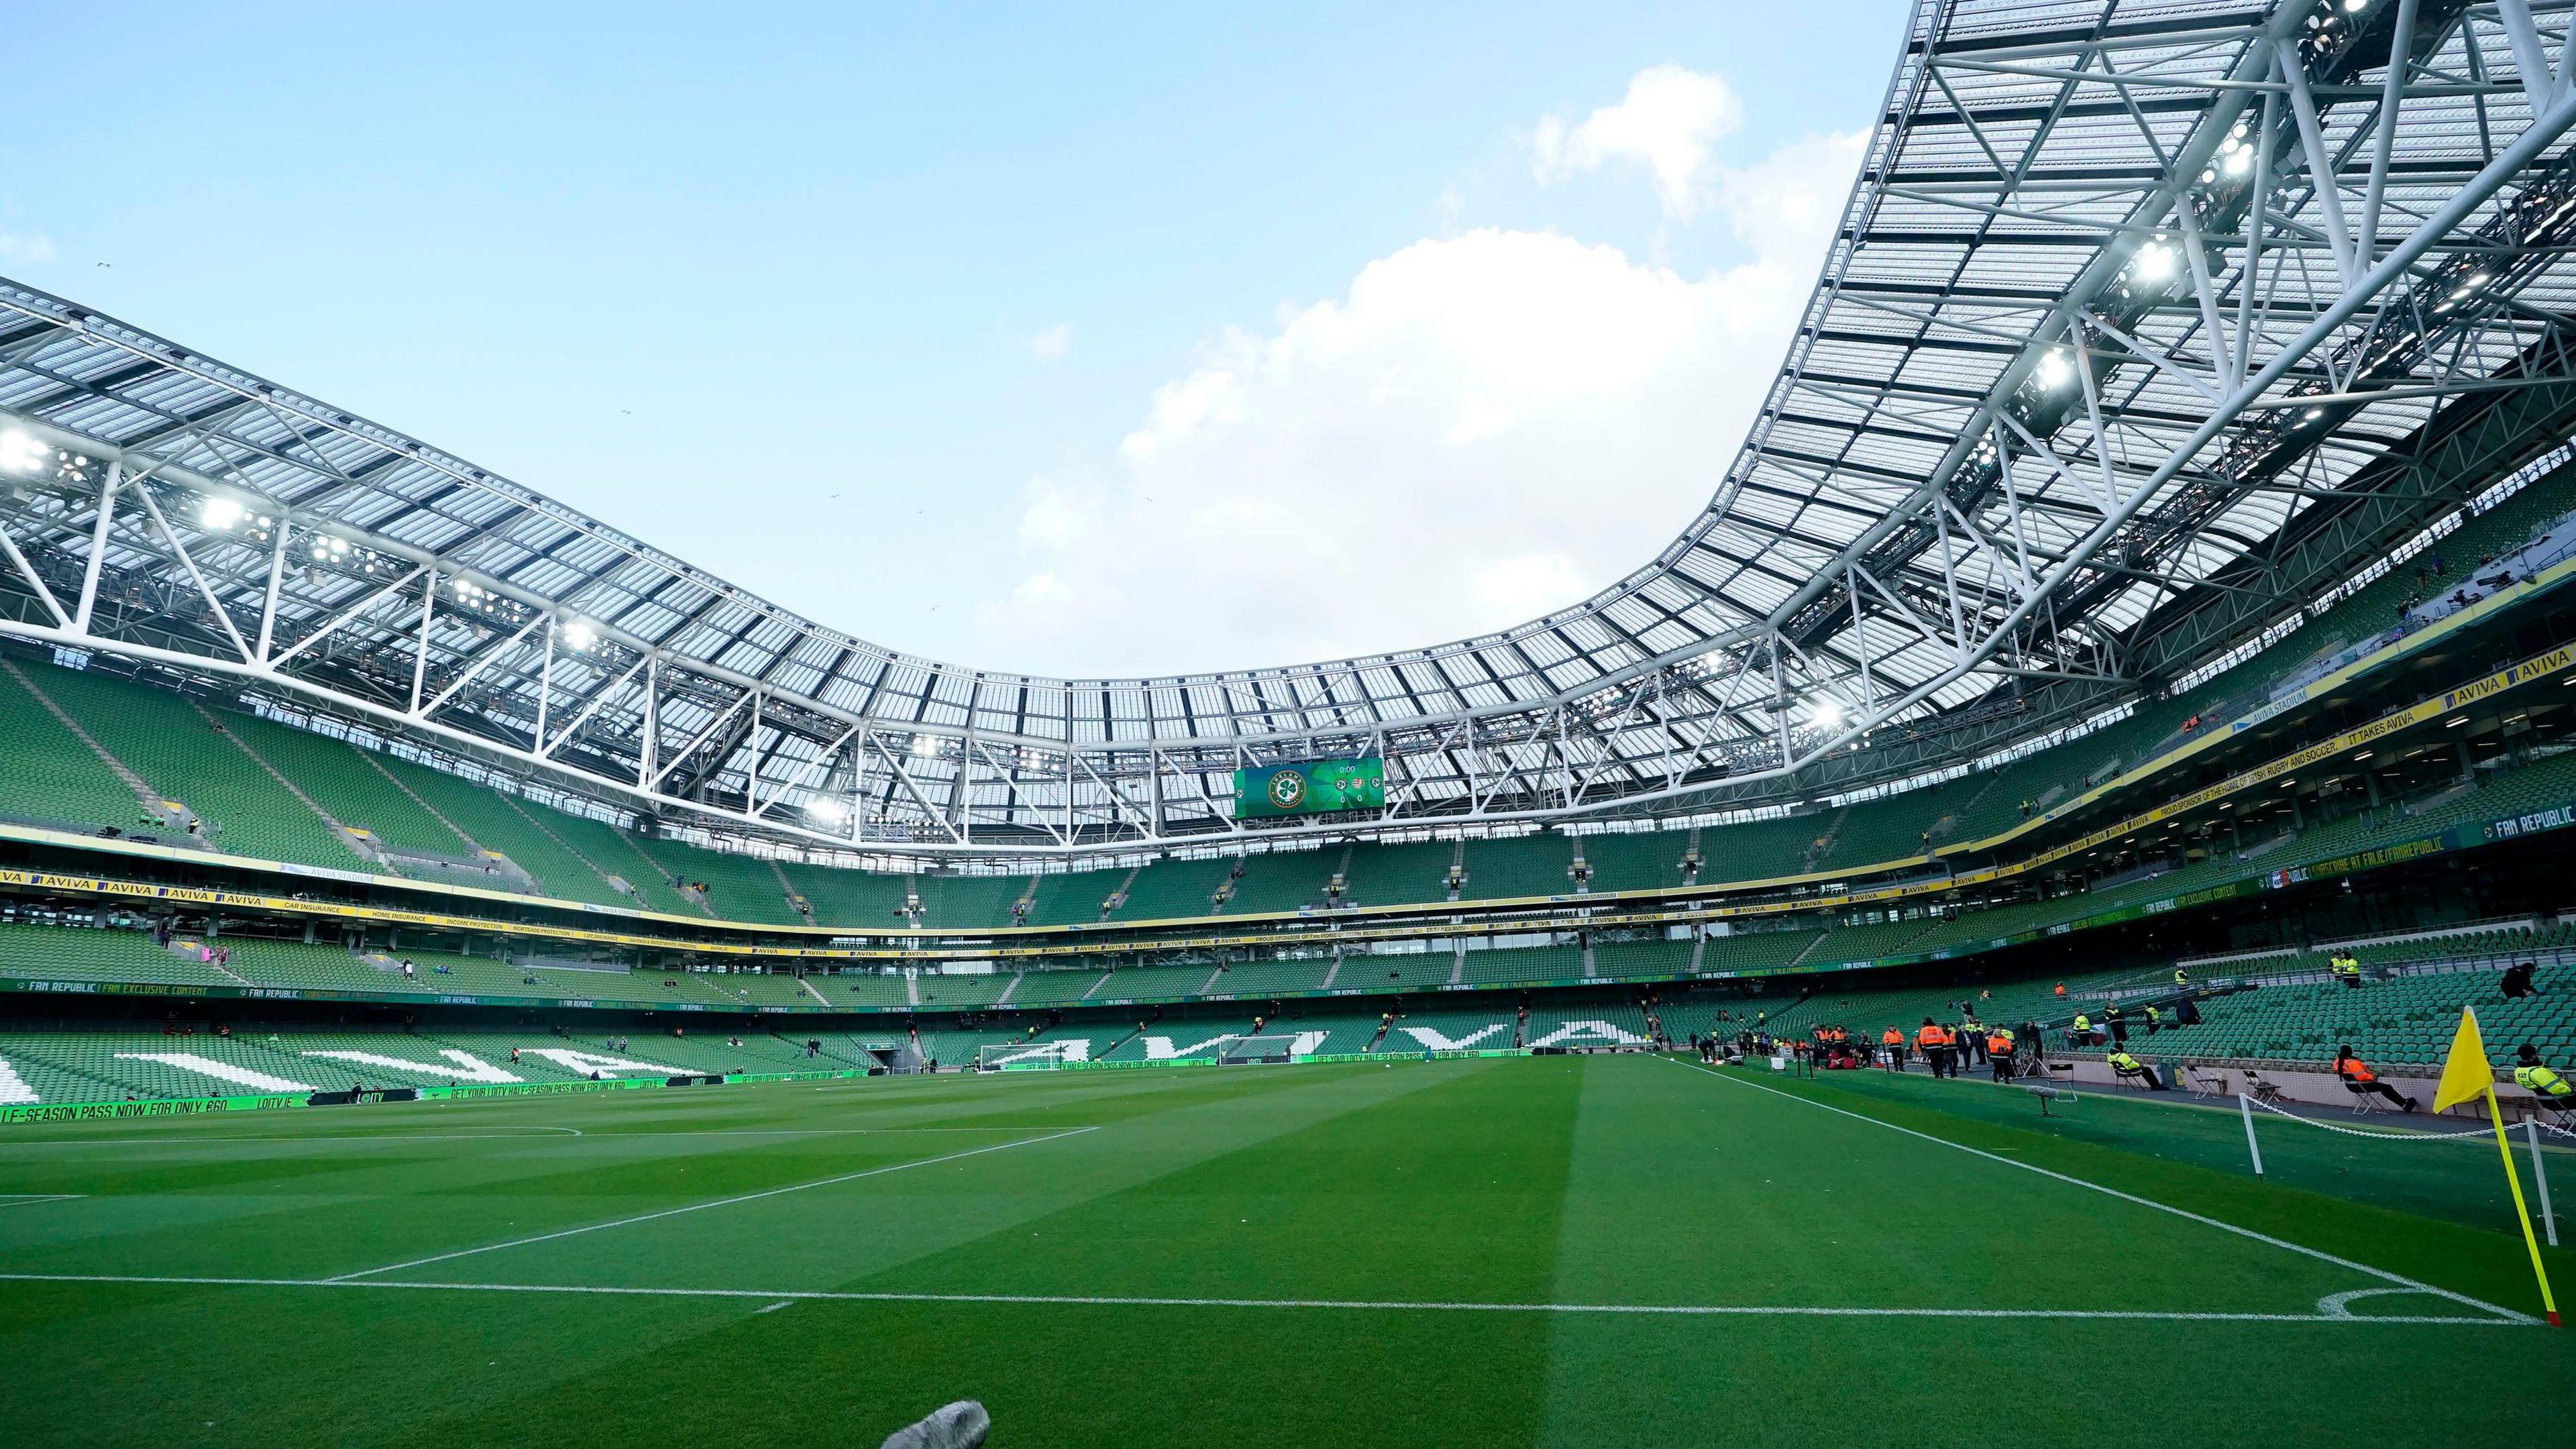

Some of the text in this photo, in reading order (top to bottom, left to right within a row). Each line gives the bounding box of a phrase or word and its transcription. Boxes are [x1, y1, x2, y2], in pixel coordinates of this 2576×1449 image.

[2522, 650, 2570, 679] AVIVA
[2459, 678, 2500, 703] AVIVA
[2253, 691, 2306, 724] AVIVA STADIUM
[2349, 711, 2415, 746] IT TAKES AVIVA
[1340, 765, 1356, 773] 0:00
[1272, 773, 1302, 785] IRELAND
[2161, 742, 2338, 817] PROUD SPONSOR OF THE HOME OF IRISH RUGBY AND SOCCER.
[1340, 796, 1346, 804] 0
[1357, 794, 1362, 802] 0
[2133, 815, 2149, 827] AVIVA
[2495, 806, 2576, 838] FAN REPUBLIC
[2110, 825, 2126, 838] AVIVA
[2090, 833, 2104, 845] AVIVA
[2054, 847, 2067, 858] AVIVA
[2072, 841, 2086, 853] AVIVA
[2312, 855, 2361, 875] SUBSCRIBE AT
[1999, 867, 2015, 876] AVIVA
[46, 877, 90, 889] AVIVA
[1956, 876, 1976, 885] AVIVA
[111, 882, 152, 895] AVIVA
[1908, 885, 1930, 894] AVIVA
[170, 889, 208, 900] AVIVA
[1854, 893, 1878, 902] AVIVA
[2146, 885, 2237, 914] FAN REPUBLIC FAN EXCLUSIVE CONTENT
[227, 895, 262, 906] AVIVA
[300, 904, 341, 913] INSURANCE
[391, 914, 426, 922] INSURANCE
[470, 921, 503, 929] PROTECTION
[2057, 924, 2071, 934] REPUBLIC
[540, 928, 570, 936] PROTECTION
[1853, 961, 1872, 969] REPUBLIC
[29, 981, 208, 996] FAN REPUBLIC FAN EXCLUSIVE CONTENT
[249, 989, 299, 999] FAN REPUBLIC
[440, 996, 451, 1004] FAN
[452, 996, 476, 1004] REPUBLIC
[574, 1000, 593, 1008] REPUBLIC
[1330, 1055, 1346, 1063] YOUR
[1346, 1054, 1364, 1062] LOITV
[1406, 1053, 1421, 1061] PASS
[1438, 1051, 1450, 1059] FOR
[1451, 1051, 1466, 1059] ONLY
[1104, 1061, 1118, 1069] PASS
[1118, 1061, 1132, 1069] NOW
[1144, 1060, 1158, 1068] ONLY
[691, 1077, 706, 1086] LOITV
[451, 1081, 614, 1099] GET YOUR LOITV HALF-SEASON PASS NOW FOR ONLY
[357, 1091, 384, 1104] LOITV
[80, 1105, 112, 1120] PASS
[116, 1103, 148, 1117] NOW
[150, 1102, 173, 1116] FOR
[174, 1100, 203, 1114] ONLY
[206, 1099, 227, 1112] €60
